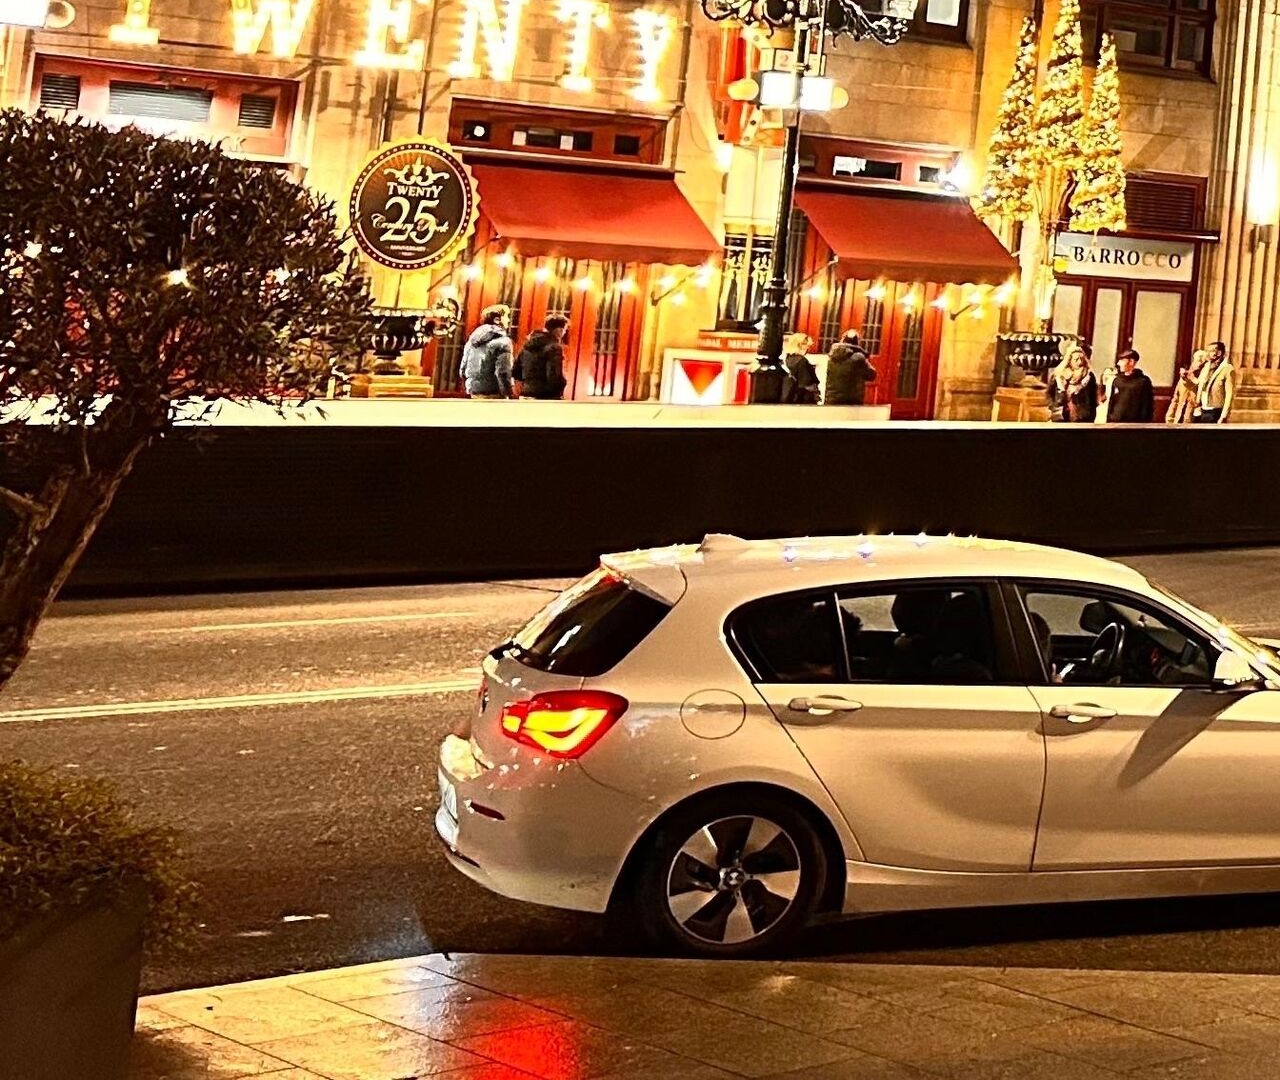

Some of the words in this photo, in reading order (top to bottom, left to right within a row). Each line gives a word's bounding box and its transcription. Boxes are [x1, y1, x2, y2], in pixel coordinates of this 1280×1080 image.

[387, 182, 443, 198] TWENTY
[380, 197, 440, 244] 25
[1074, 246, 1182, 269] BARROCCO
